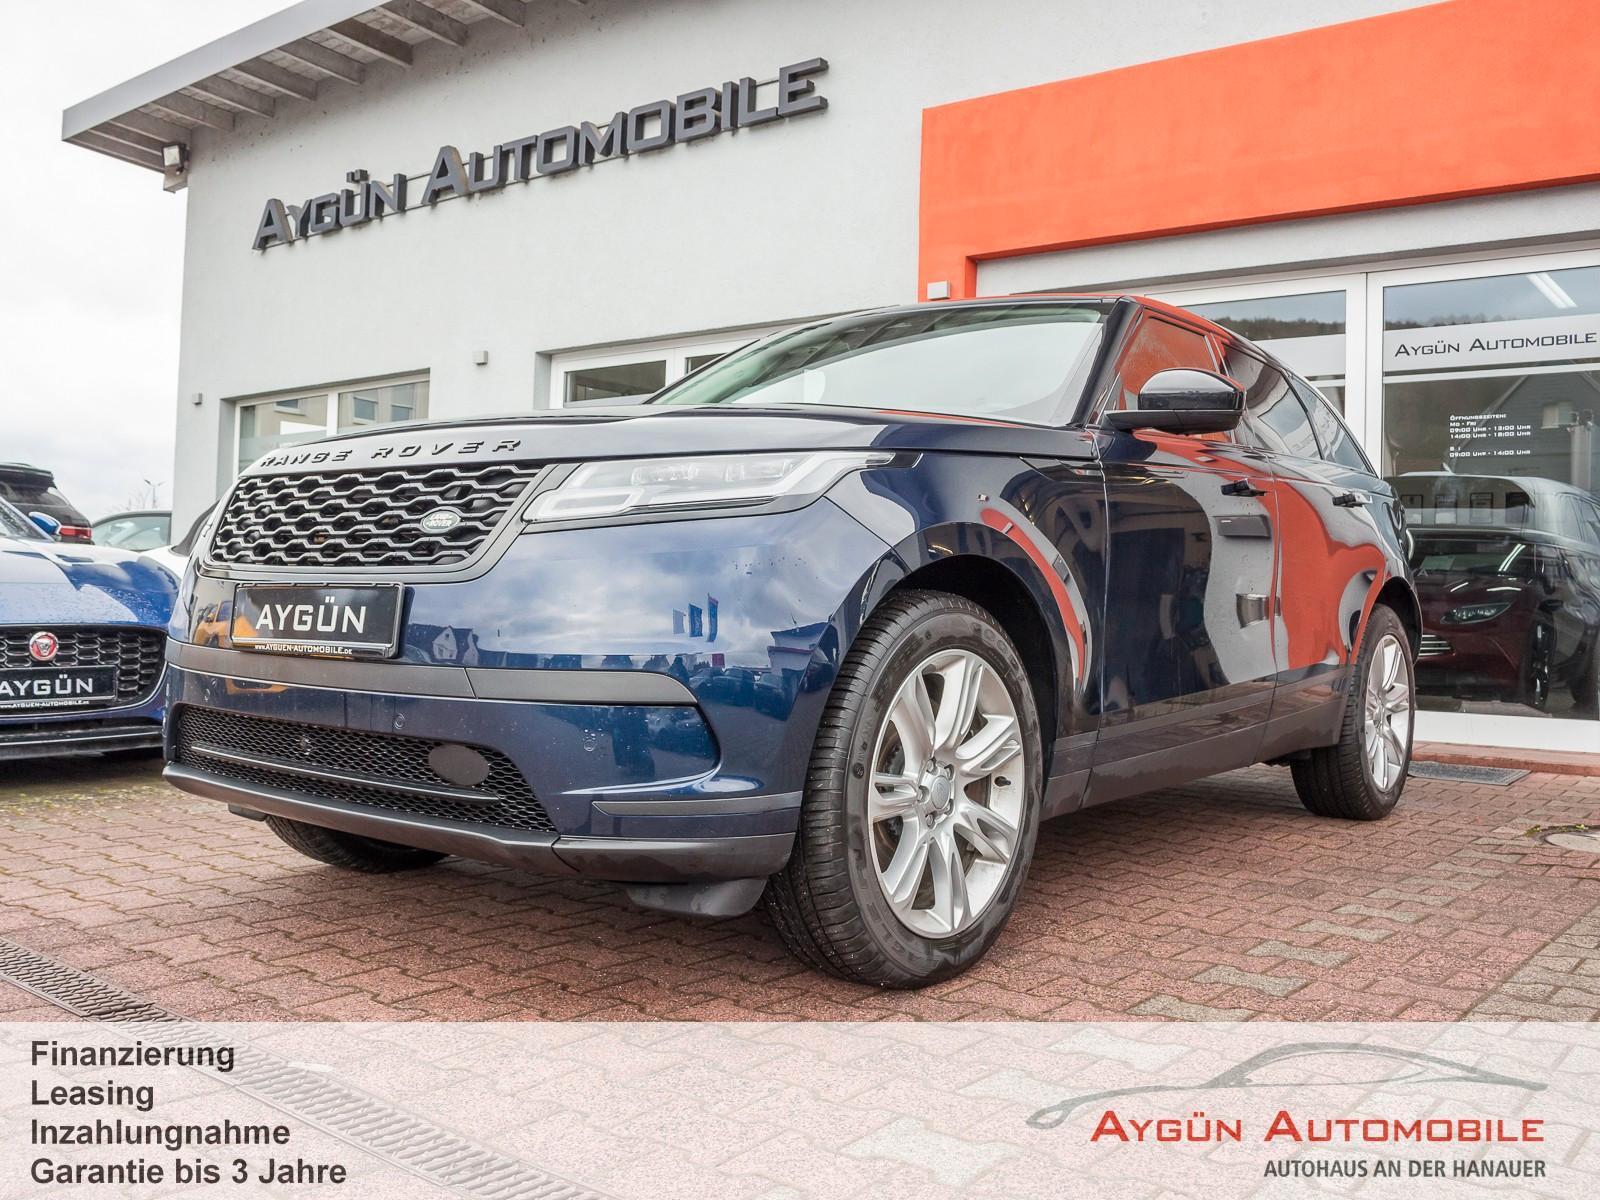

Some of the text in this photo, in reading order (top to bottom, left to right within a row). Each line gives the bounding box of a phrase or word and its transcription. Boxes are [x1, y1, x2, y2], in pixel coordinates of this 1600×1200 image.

[252, 56, 830, 251] AYGÜN AUTOMOBILE
[1394, 332, 1597, 357] AYGÜN AUTOMOBILE
[259, 439, 522, 468] RANGE ROVER
[255, 596, 367, 634] AYGÜN
[0, 673, 94, 697] AYGÜN
